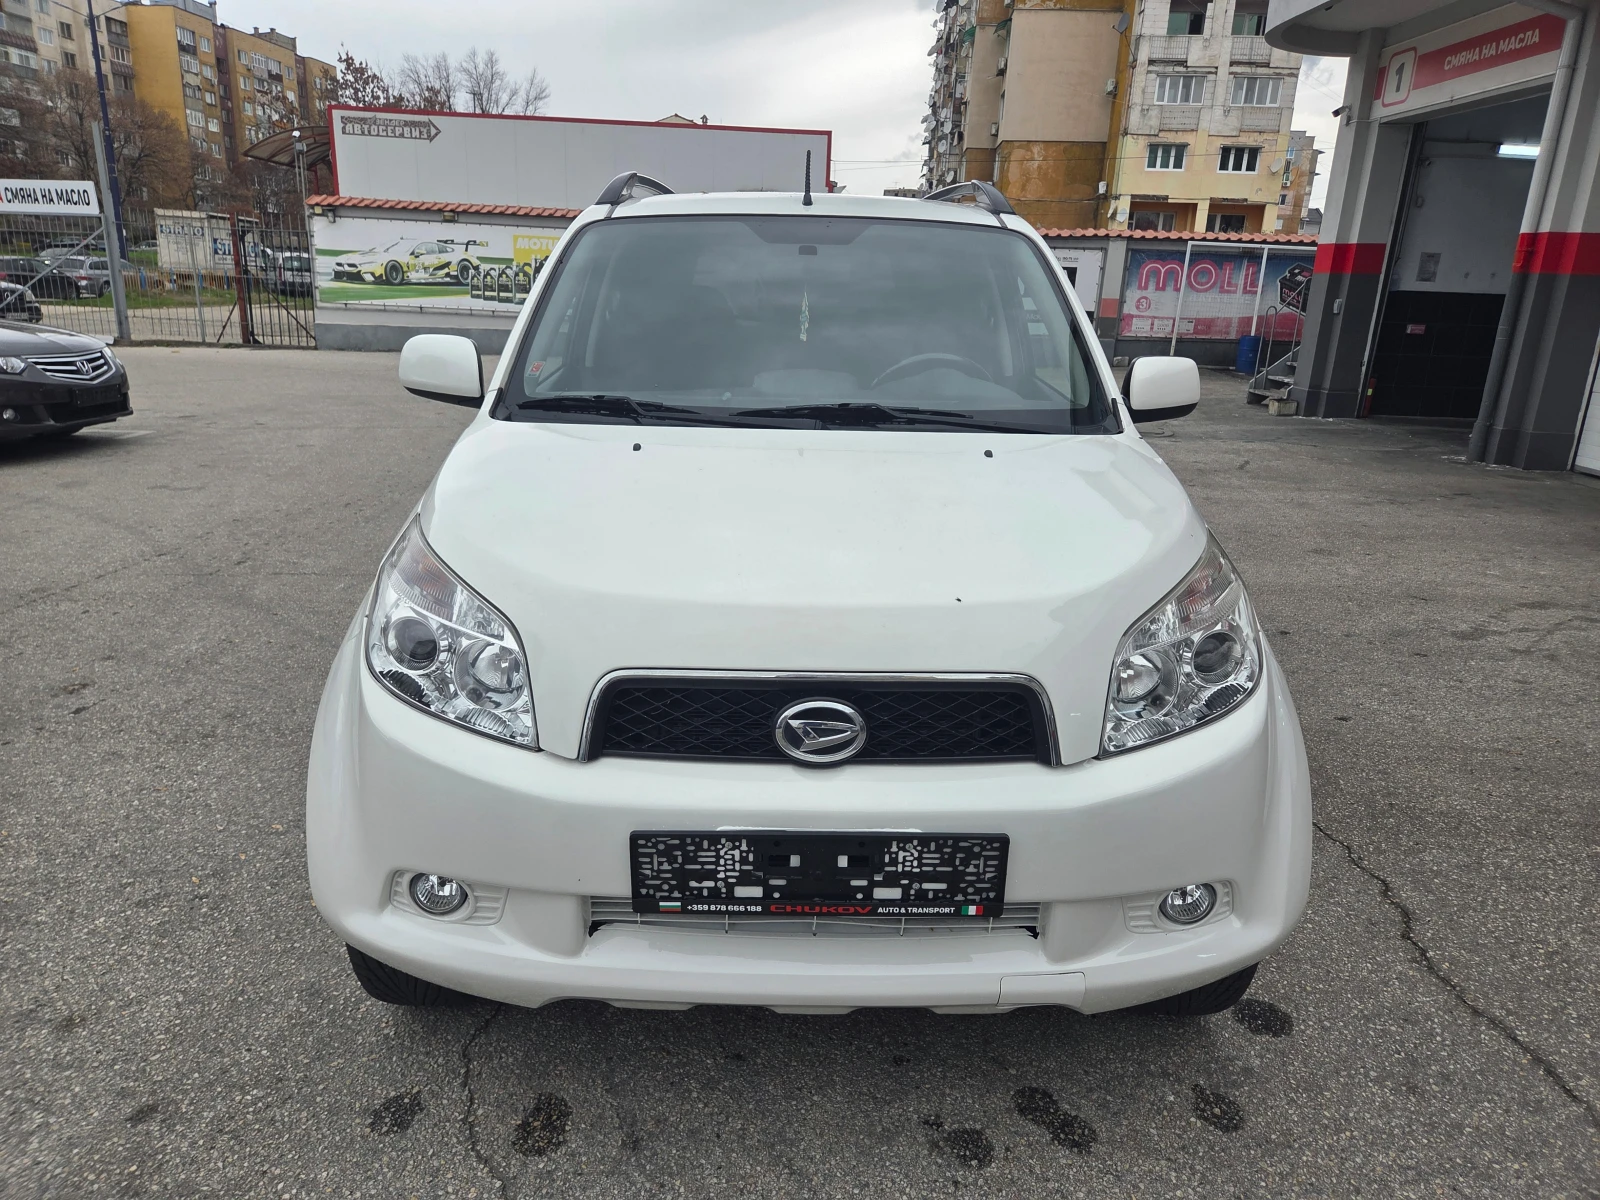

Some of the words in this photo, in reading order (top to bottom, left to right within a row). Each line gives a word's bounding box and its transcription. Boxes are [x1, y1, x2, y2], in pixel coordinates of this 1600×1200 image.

[1444, 49, 1480, 70] СМЯНА
[1481, 42, 1497, 58] НА
[1498, 28, 1540, 53] МАСЛА
[1395, 62, 1405, 93] 1
[345, 123, 428, 139] АВТОСЕРВИЗ
[4, 186, 40, 205] СМЯНА
[40, 187, 55, 205] НА
[55, 188, 91, 206] МАСЛО
[516, 237, 558, 251] MOTU
[769, 904, 873, 913] CHUKOV
[877, 906, 900, 914] AUTO
